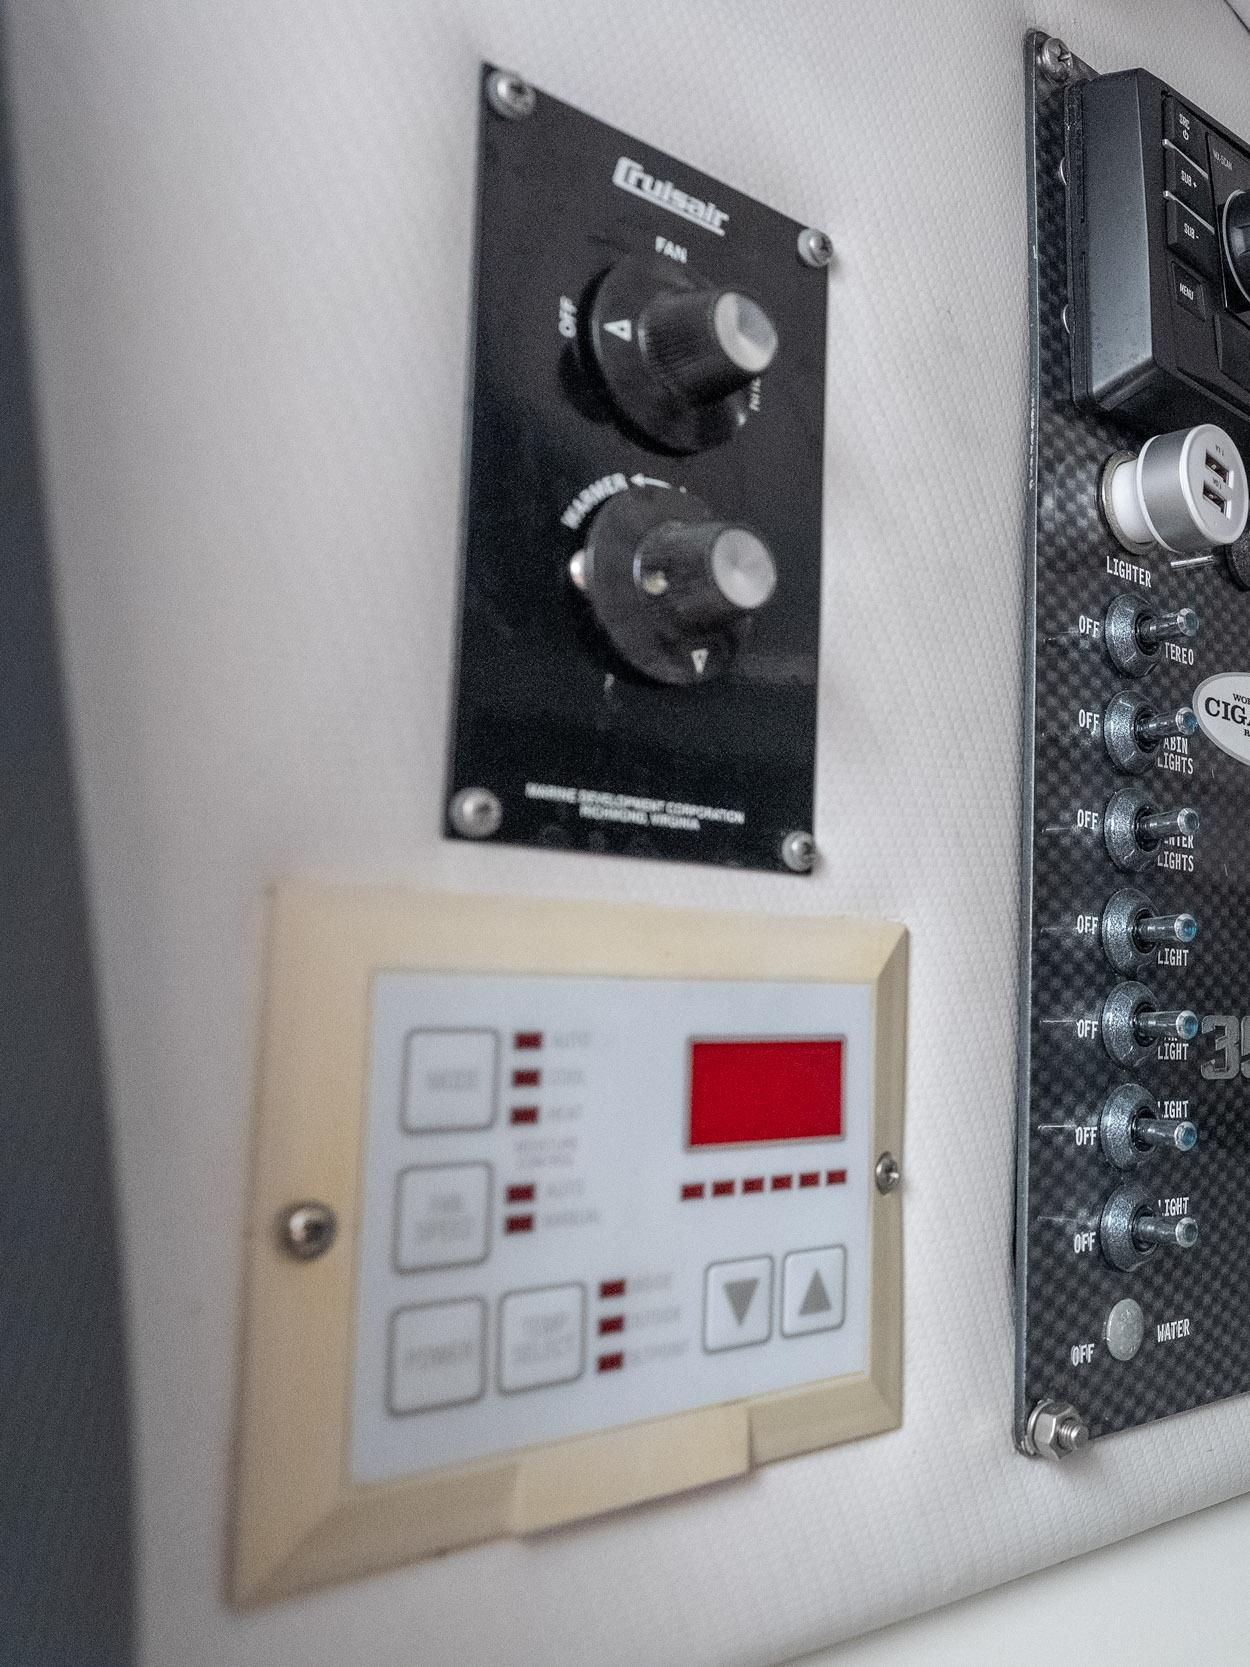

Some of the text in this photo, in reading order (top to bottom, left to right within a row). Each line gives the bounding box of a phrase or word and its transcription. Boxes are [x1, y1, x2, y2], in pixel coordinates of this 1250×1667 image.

[1181, 170, 1192, 187] SUB
[1183, 222, 1195, 239] SUB
[655, 236, 688, 264] FAN
[1179, 282, 1194, 300] MENU
[558, 295, 577, 338] OFF
[1106, 555, 1152, 588] LIGHTER
[1079, 614, 1100, 639] OFF
[1164, 641, 1194, 666] TEREO
[1078, 709, 1100, 733] OFF
[1163, 736, 1188, 755] ABIN
[1157, 751, 1194, 775] LIGHTS
[1076, 809, 1099, 830] OFF
[1157, 851, 1194, 872] LIGHTS
[1077, 914, 1099, 934] OFF
[1157, 947, 1189, 966] LIGHT
[1077, 1019, 1099, 1039] OFF
[1157, 1042, 1189, 1060] LIGHT
[1075, 1127, 1098, 1146] OFF
[1073, 1231, 1097, 1253] OFF
[1157, 1318, 1190, 1343] WATER
[1070, 1343, 1095, 1366] OFF
